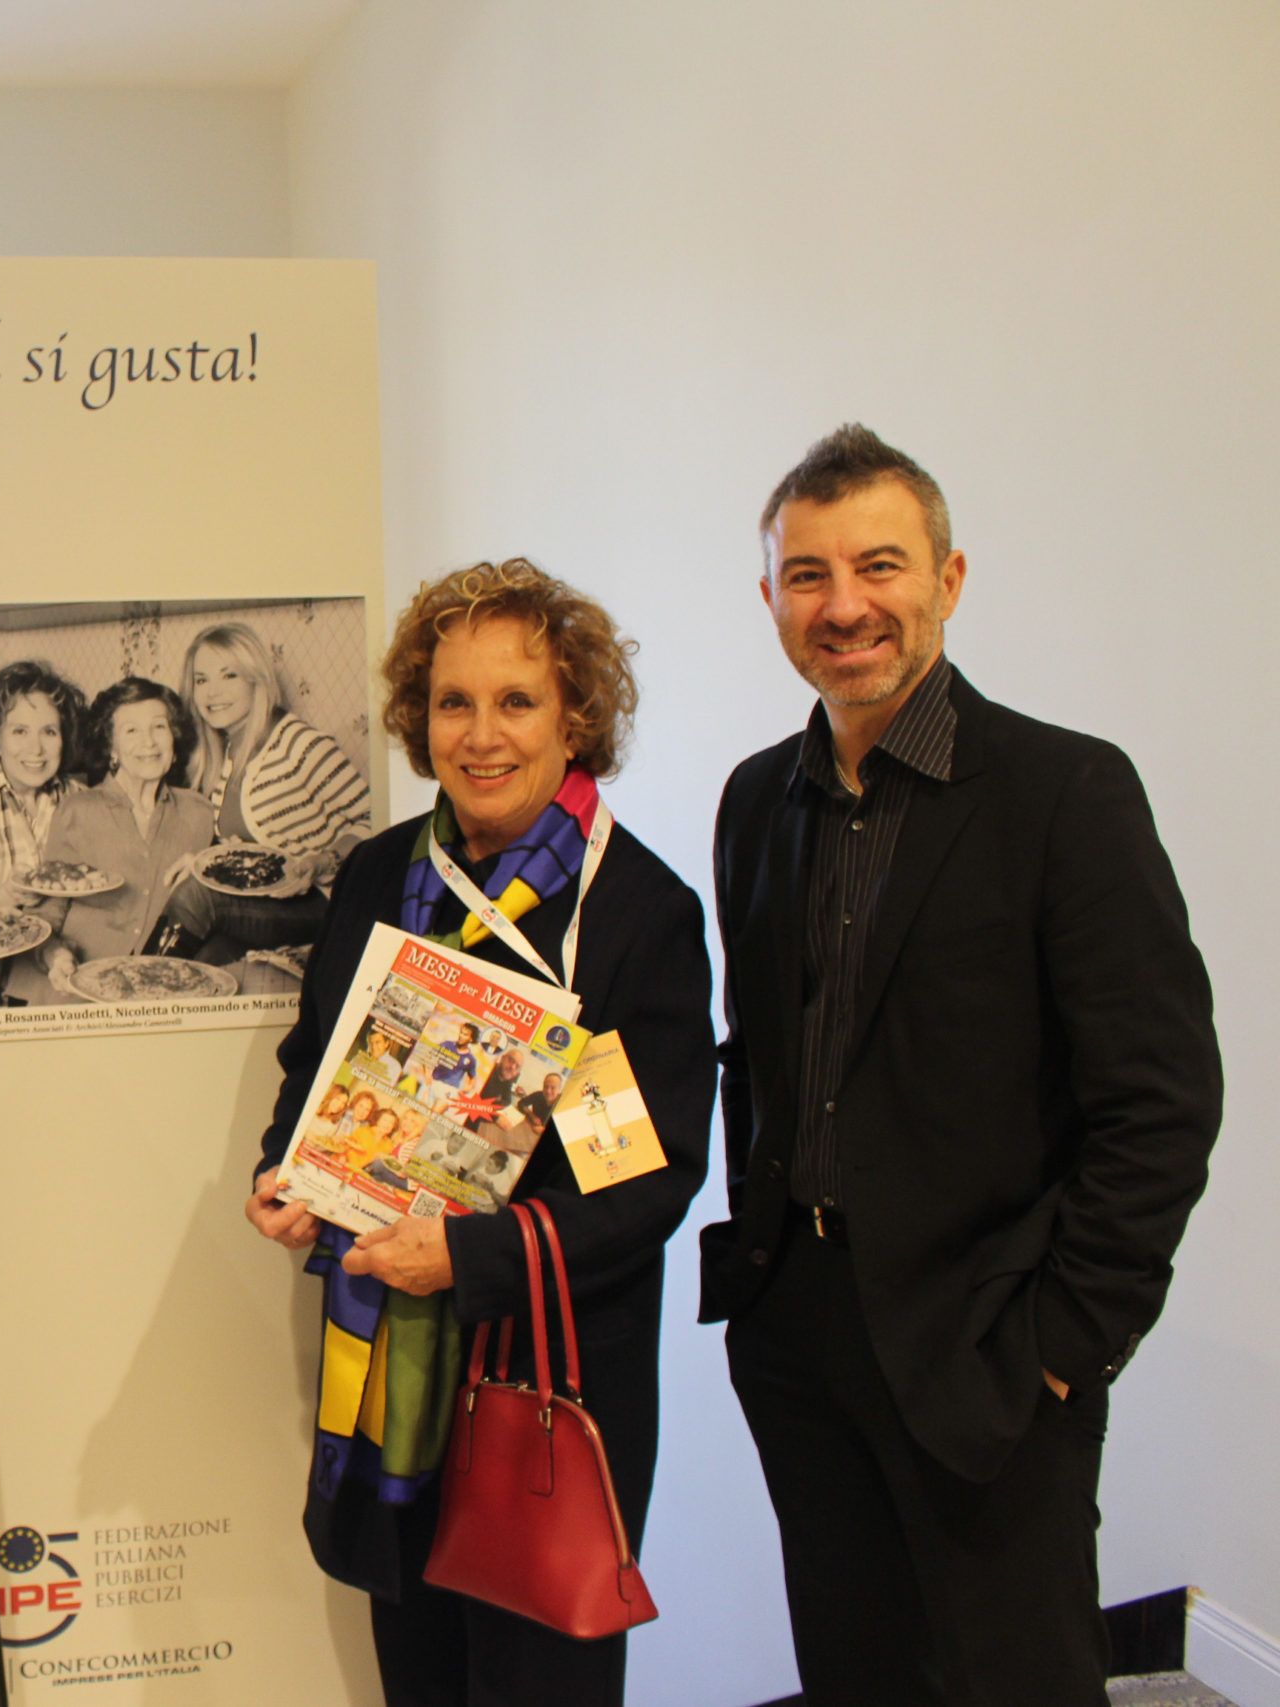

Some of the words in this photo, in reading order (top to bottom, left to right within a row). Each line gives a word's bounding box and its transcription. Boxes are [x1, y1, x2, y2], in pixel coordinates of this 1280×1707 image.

[22, 332, 68, 383] si
[80, 332, 258, 411] gusta!
[405, 946, 462, 987] MESE
[458, 982, 479, 997] per
[480, 985, 538, 1027] MESE
[5, 1013, 56, 1024] Rosanna
[59, 1008, 112, 1021] Vaudetti,
[116, 1005, 168, 1017] Nicoletta
[171, 1001, 240, 1014] Orsomando
[242, 1002, 249, 1010] e
[252, 998, 286, 1009] Maria
[95, 1518, 231, 1545] FEDERAZIONE
[95, 1544, 186, 1566] ITALIANA
[95, 1564, 184, 1587] PUBBLICI
[96, 1585, 182, 1608] ESERCIZI
[20, 1640, 233, 1679] CONFCOMMERCIO
[52, 1674, 114, 1687] IMPRESE
[117, 1671, 144, 1681] PER
[147, 1665, 201, 1678] L'ITALIA
